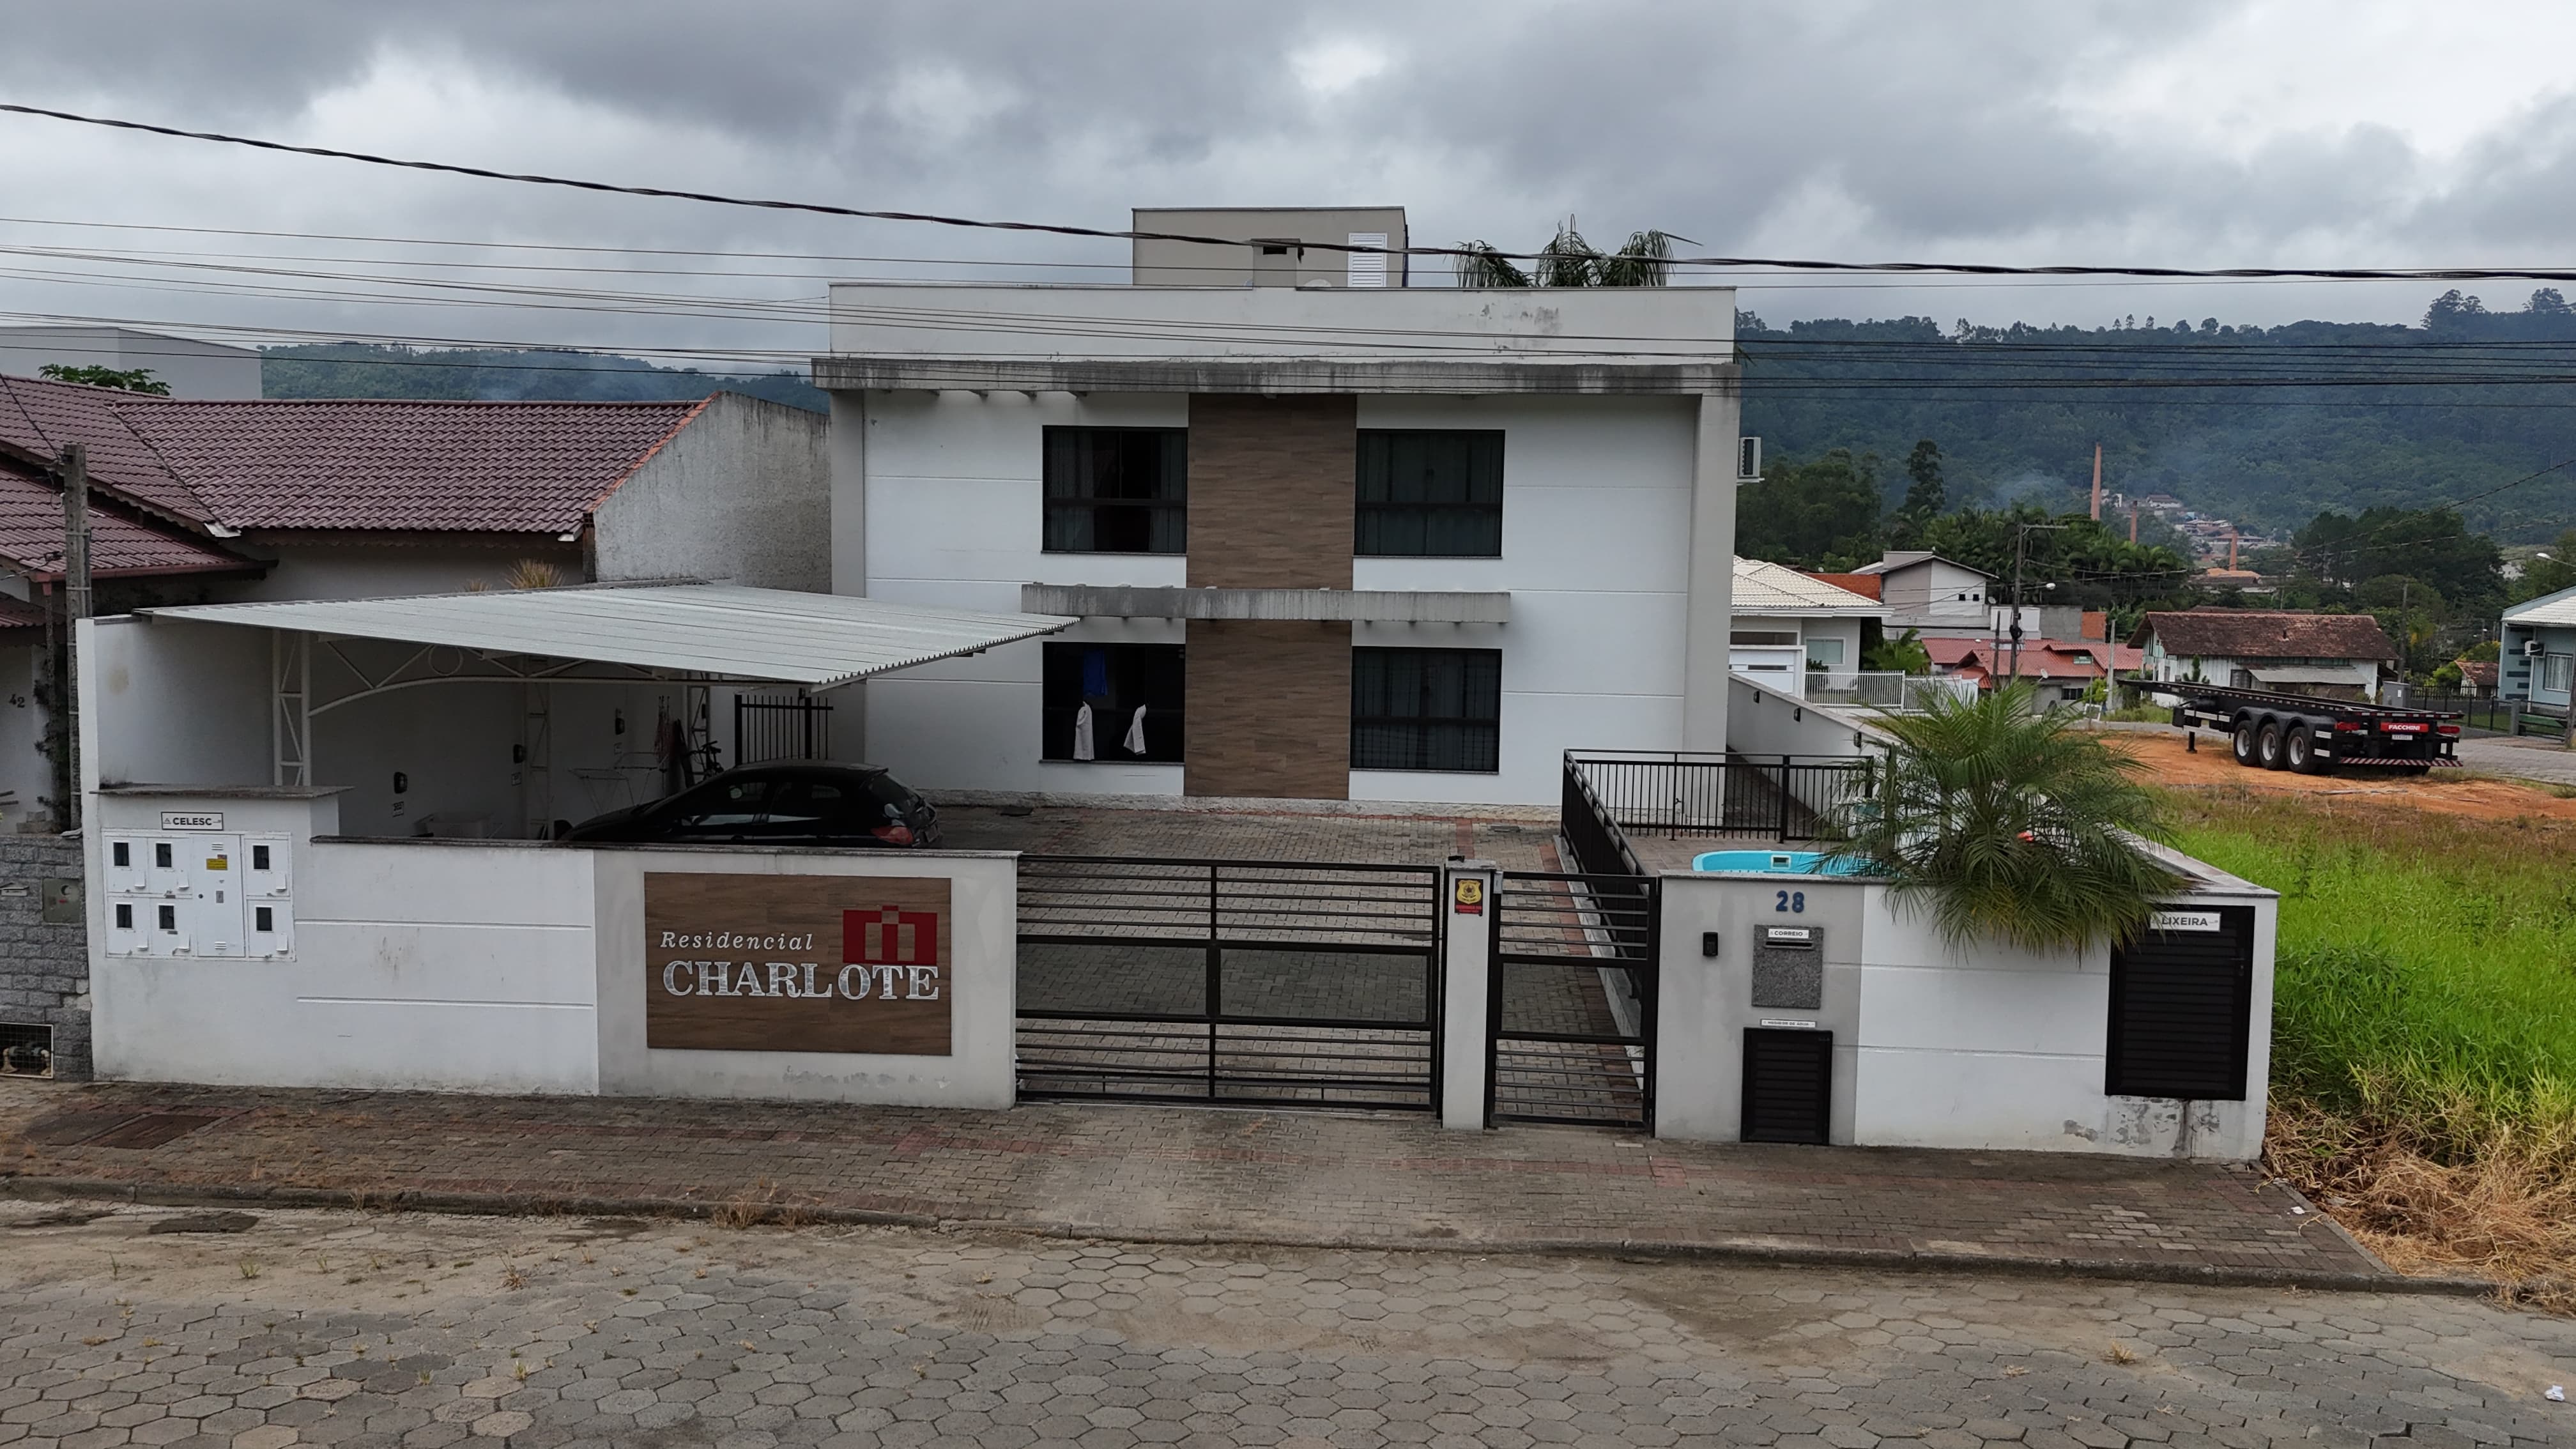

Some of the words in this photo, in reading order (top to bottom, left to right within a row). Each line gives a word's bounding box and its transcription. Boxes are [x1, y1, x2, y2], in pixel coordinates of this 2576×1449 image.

[9, 694, 25, 708] 42
[172, 817, 212, 825] CELESC
[1775, 890, 1804, 914] 28
[2161, 917, 2208, 926] LIXEIRA
[660, 931, 813, 951] Residencial
[662, 960, 940, 1000] CHARLOTE
